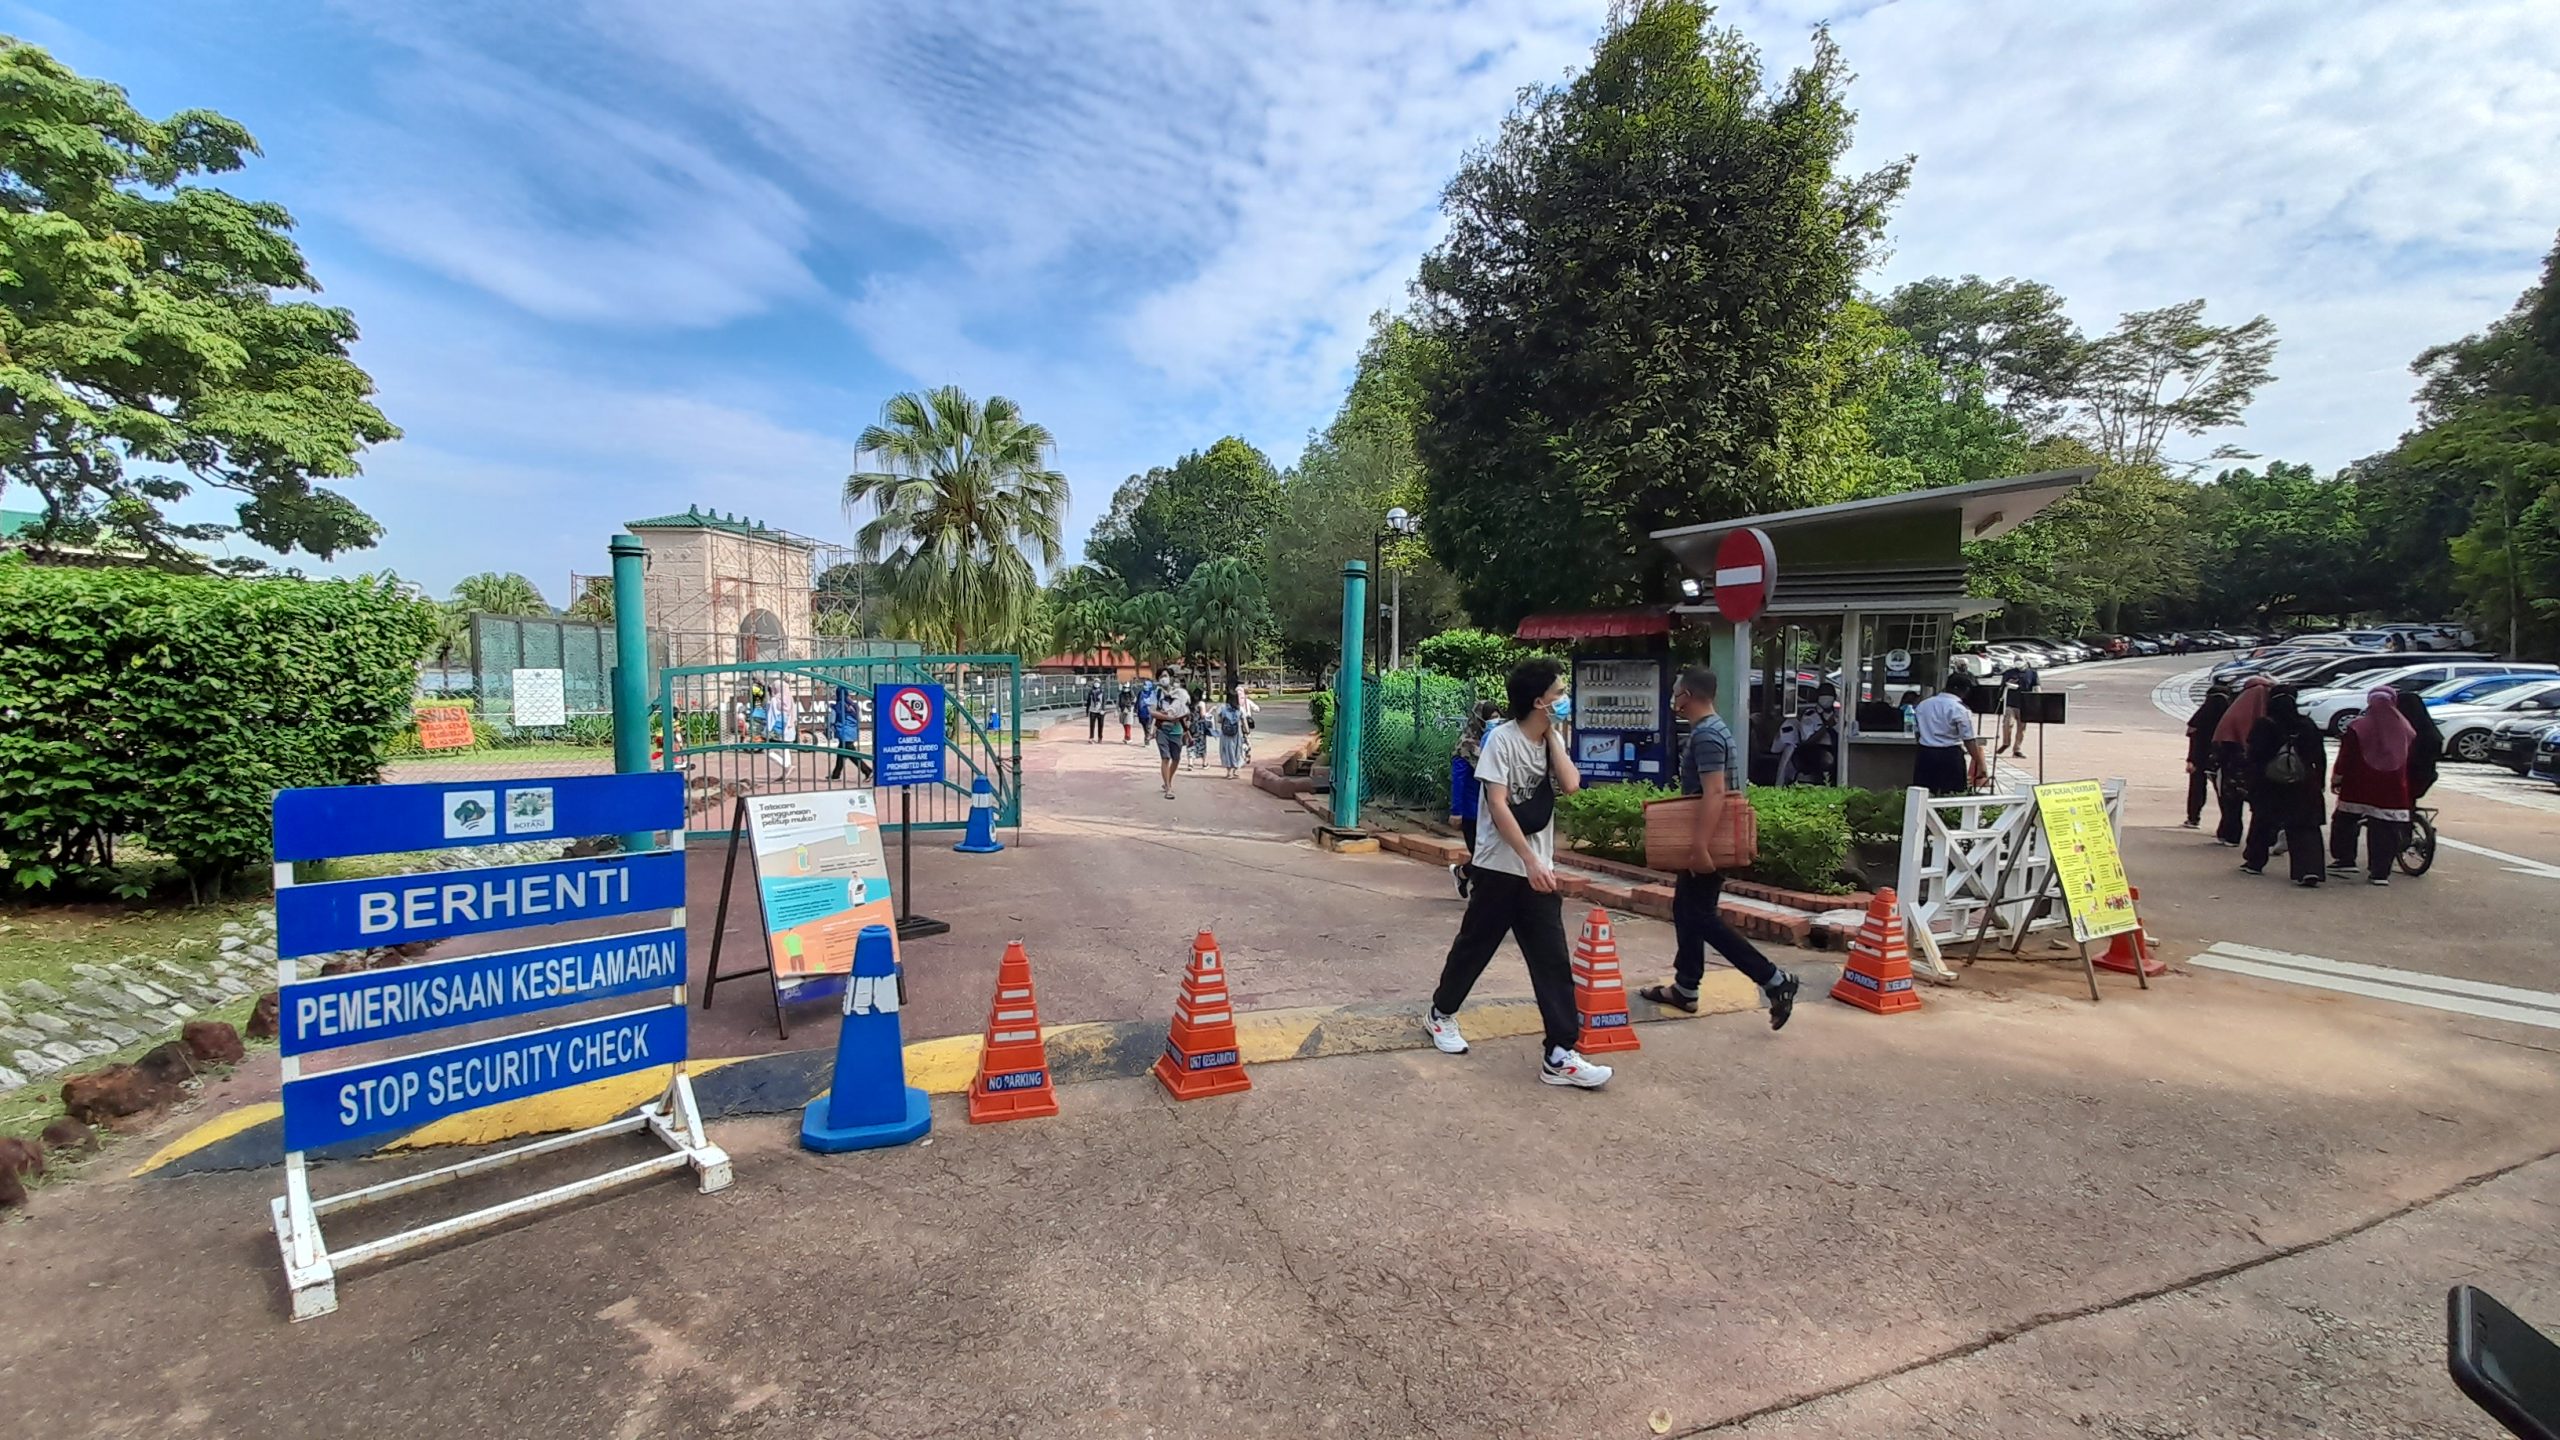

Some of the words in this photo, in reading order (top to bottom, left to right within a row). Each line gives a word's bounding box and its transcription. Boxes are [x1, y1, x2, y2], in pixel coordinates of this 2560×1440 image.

[894, 753, 917, 761] FILMING
[886, 762, 920, 770] PROHIBITED
[759, 803, 796, 811] Tatacara
[761, 809, 812, 820] penggunaan
[762, 817, 790, 828] pelitup
[791, 813, 817, 824] muka?
[359, 866, 630, 935] BERHENTI
[1845, 969, 1854, 981] NO
[1854, 973, 1879, 991] PARKING
[297, 968, 504, 1040] PEMERIKSAAN
[511, 940, 676, 1002] KESELAMATAN
[1591, 1015, 1601, 1027] NO
[1601, 1013, 1627, 1026] PARKING
[339, 1074, 419, 1126] STOP
[427, 1039, 563, 1105] SECURITY
[568, 1023, 649, 1071] CHECK
[988, 1076, 1002, 1090] NO
[1003, 1071, 1042, 1088] PARKING
